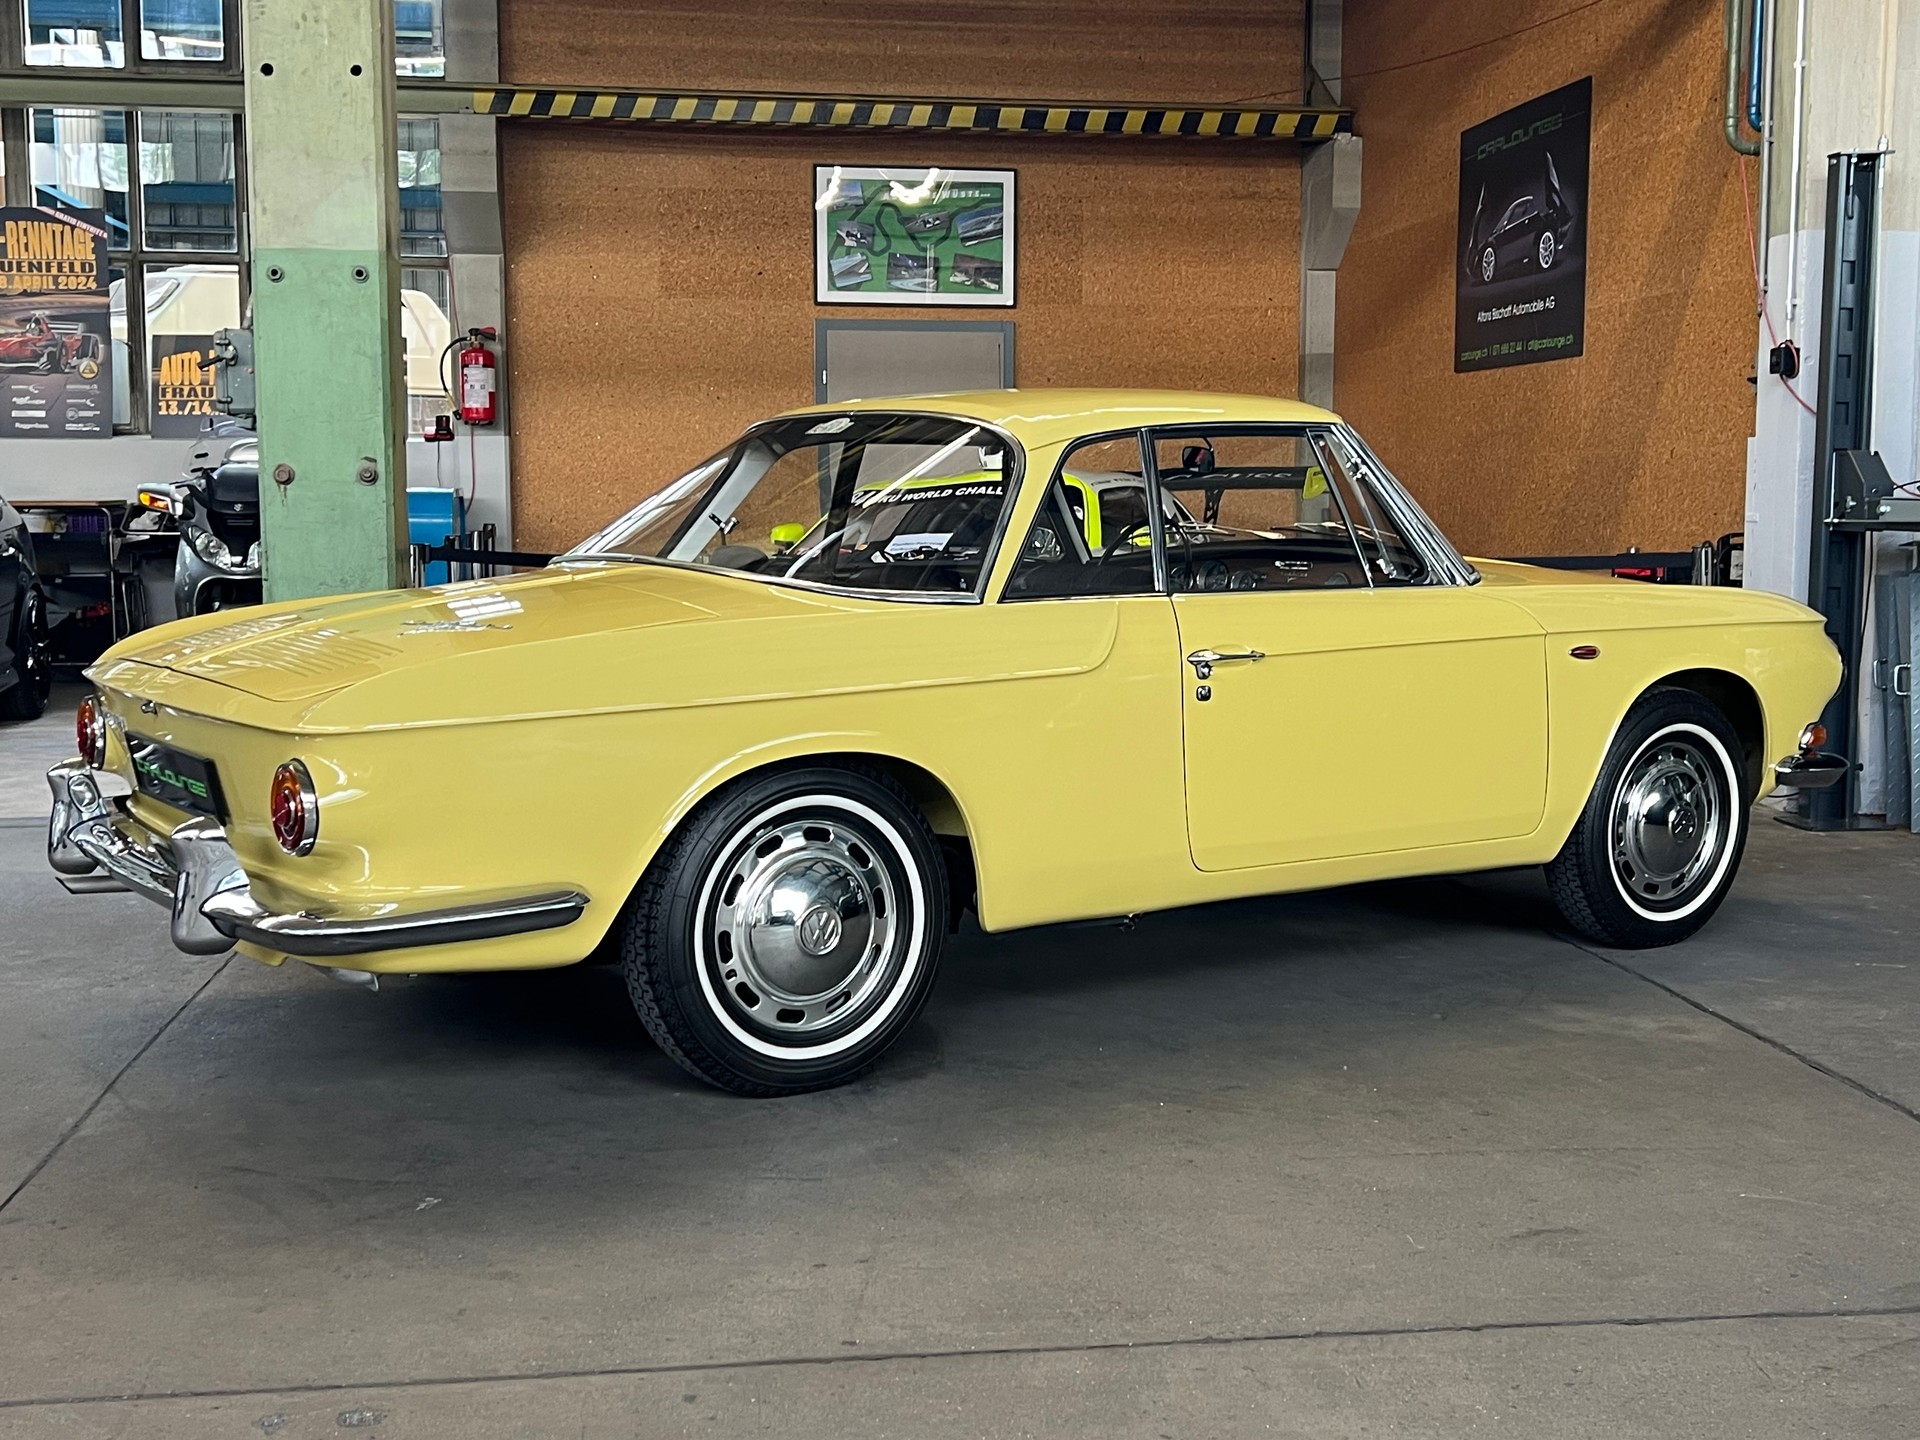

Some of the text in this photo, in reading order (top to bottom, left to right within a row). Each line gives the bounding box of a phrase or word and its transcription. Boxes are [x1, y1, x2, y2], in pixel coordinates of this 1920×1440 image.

[58, 276, 97, 290] 2024
[1512, 298, 1545, 316] Automobile
[1545, 295, 1556, 310] AG
[160, 386, 214, 399] FRAU
[901, 488, 953, 502] WORLD
[955, 485, 1004, 497] CHALL
